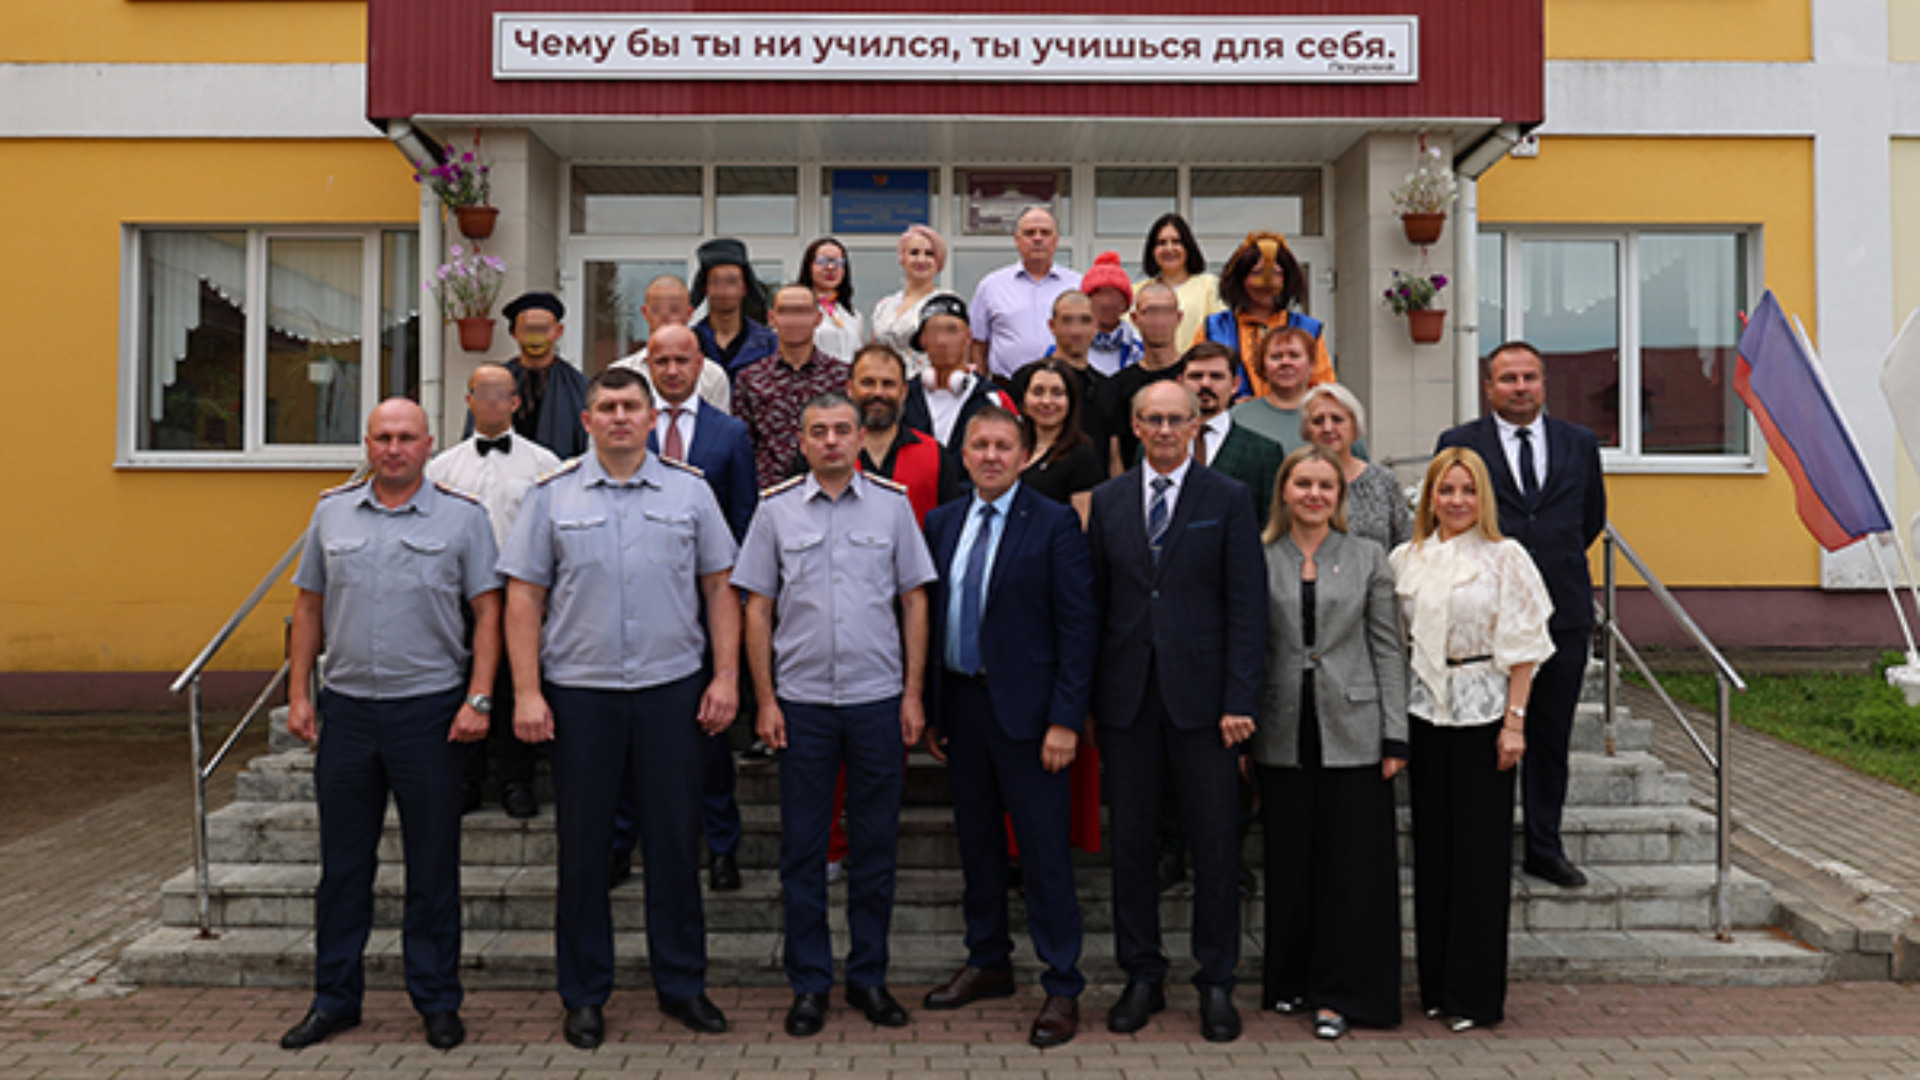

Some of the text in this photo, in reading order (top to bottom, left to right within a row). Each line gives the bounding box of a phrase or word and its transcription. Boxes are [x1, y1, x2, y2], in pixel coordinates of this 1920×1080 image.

[514, 28, 1396, 64] Чему бы ты ни учился, ты учишься для себя.
